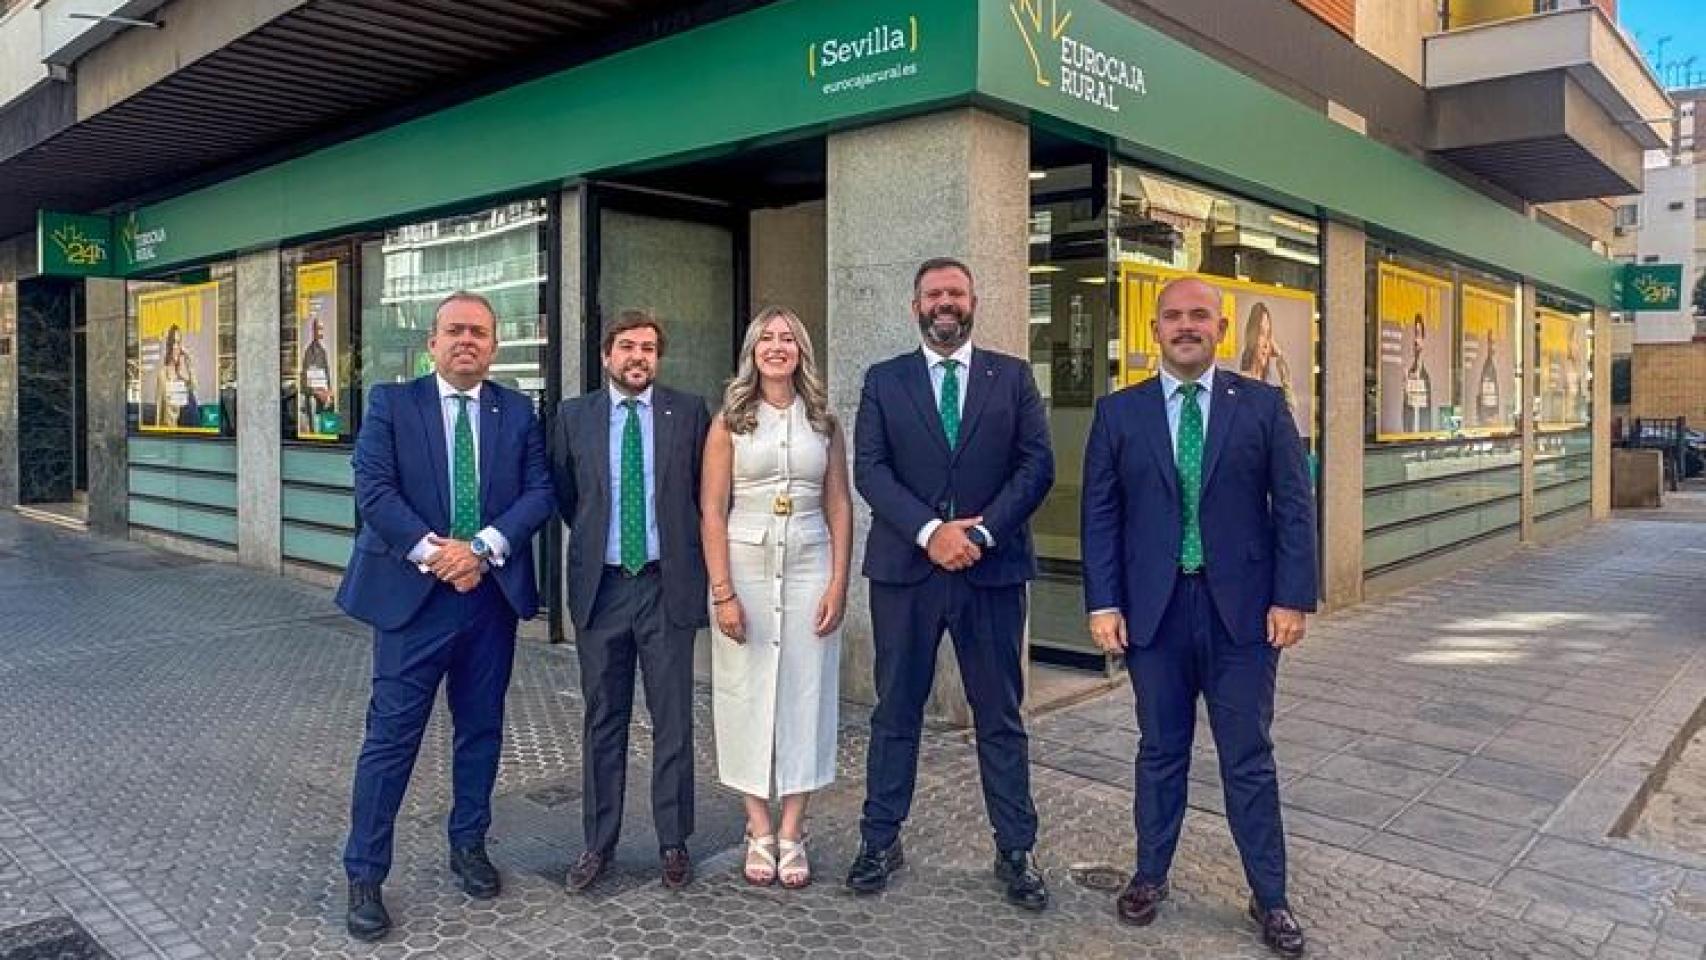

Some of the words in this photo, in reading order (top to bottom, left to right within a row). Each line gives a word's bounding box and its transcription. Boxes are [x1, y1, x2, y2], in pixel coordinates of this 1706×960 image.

[1061, 35, 1147, 94] EUROCAJA
[1061, 65, 1120, 112] RURAL
[67, 242, 107, 265] 24h
